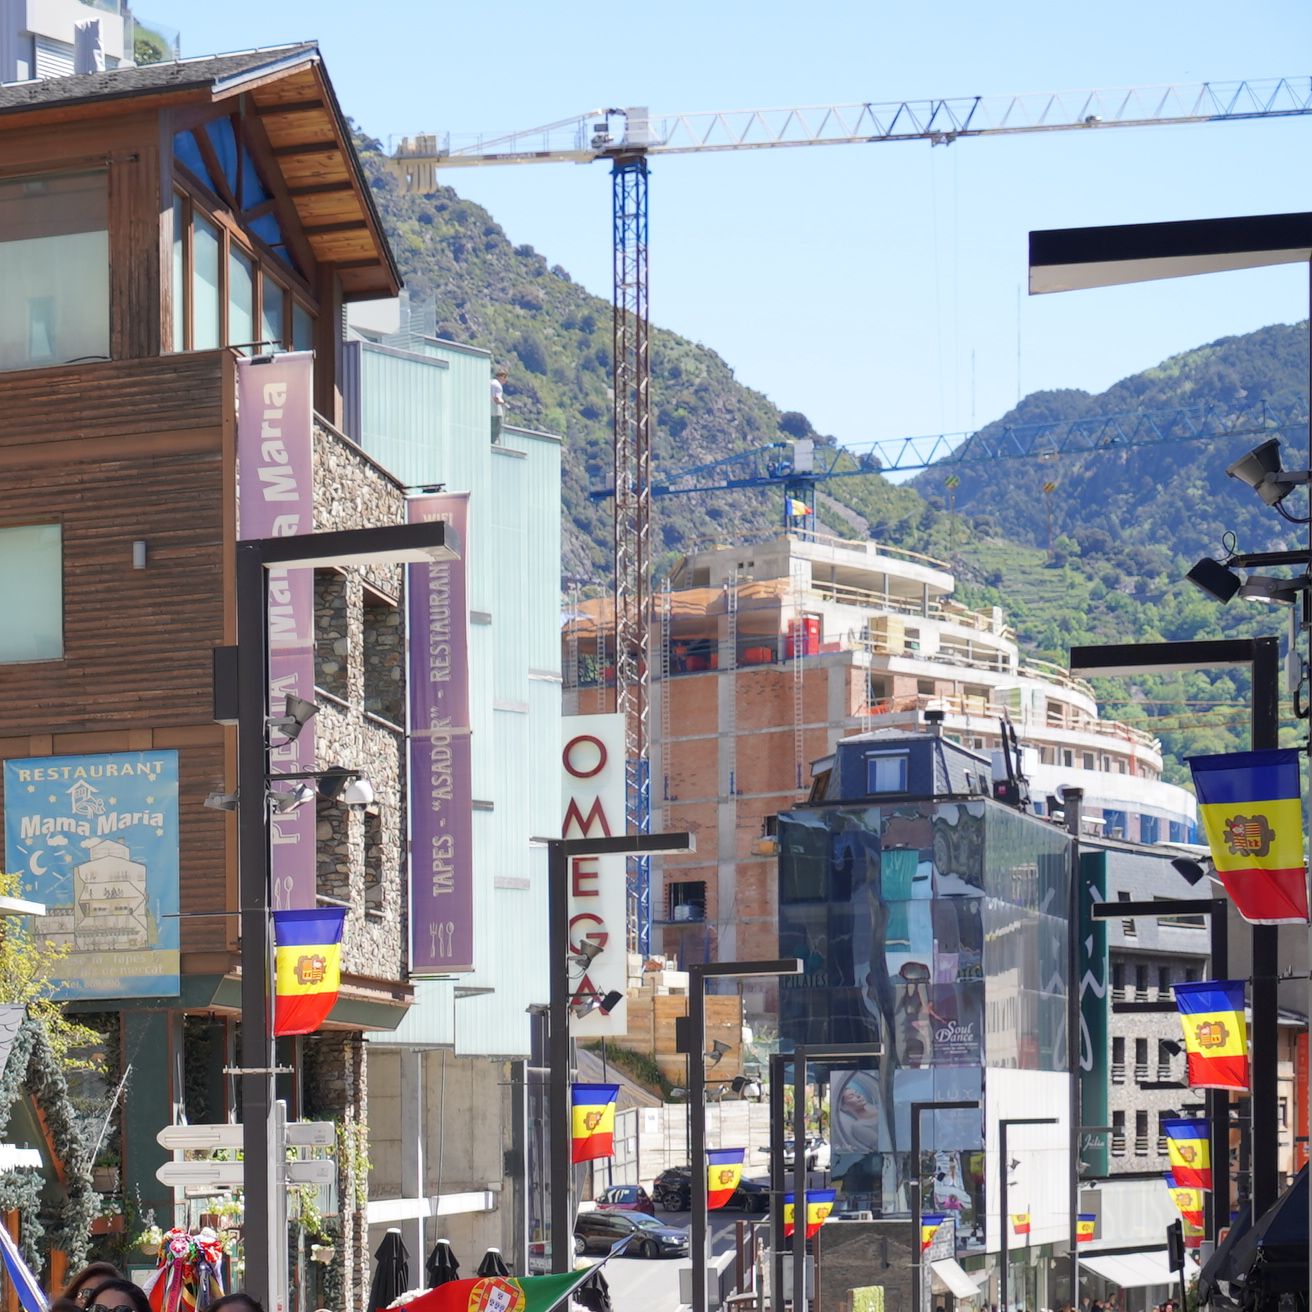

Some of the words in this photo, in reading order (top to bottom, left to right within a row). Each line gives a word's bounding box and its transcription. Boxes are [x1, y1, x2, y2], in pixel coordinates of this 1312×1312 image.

[257, 382, 300, 501] Maria
[19, 760, 164, 782] RESTAURANT
[20, 815, 90, 838] Mama
[97, 809, 163, 836] Maria
[433, 834, 455, 896] TAPES
[562, 735, 612, 1016] OMEGA
